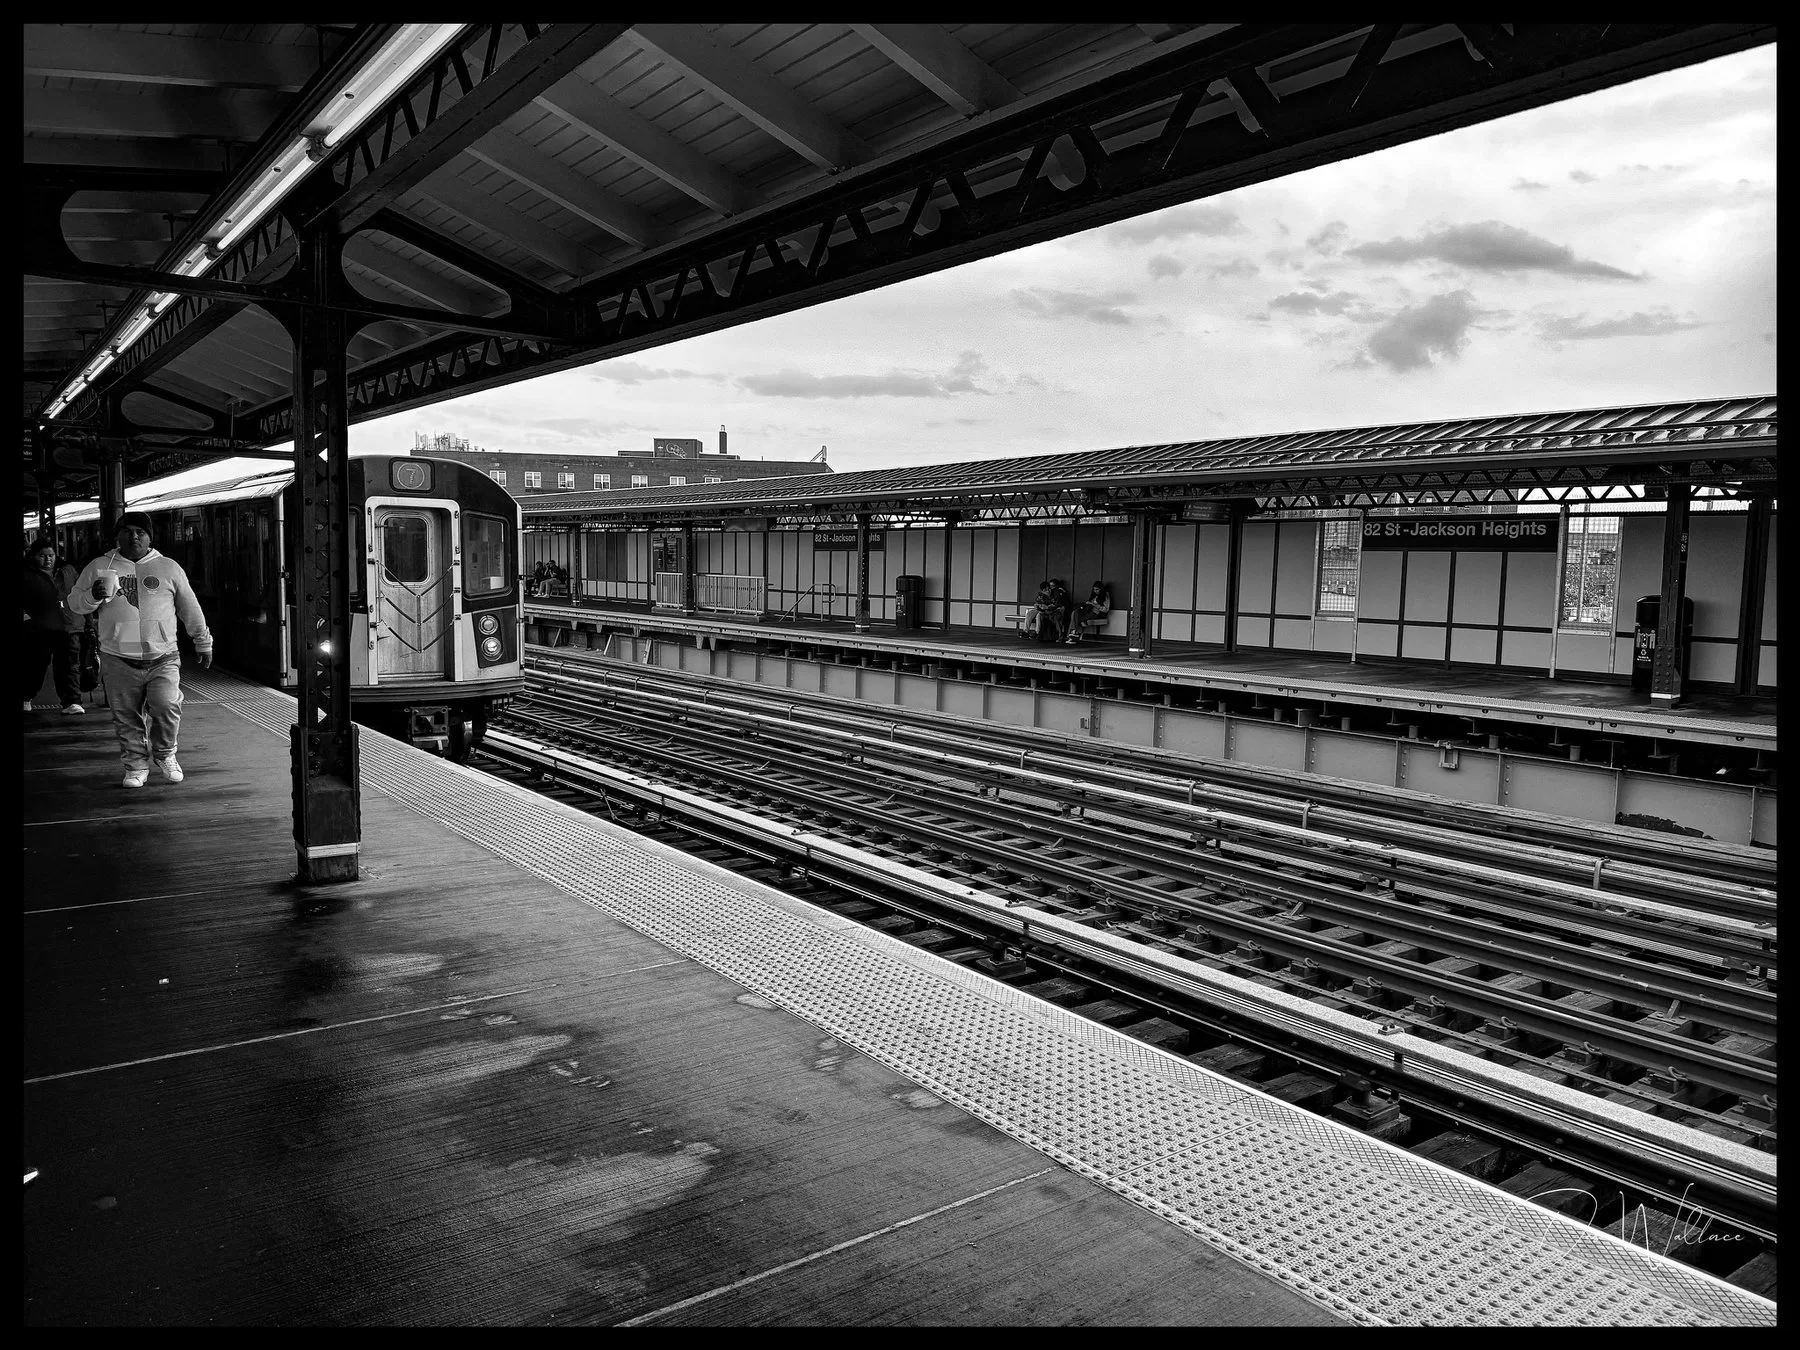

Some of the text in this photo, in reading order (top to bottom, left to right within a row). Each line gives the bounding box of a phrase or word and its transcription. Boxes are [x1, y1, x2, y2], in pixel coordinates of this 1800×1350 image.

[1363, 522, 1381, 536] 82
[1481, 521, 1547, 539] Heights
[814, 533, 822, 543] 82
